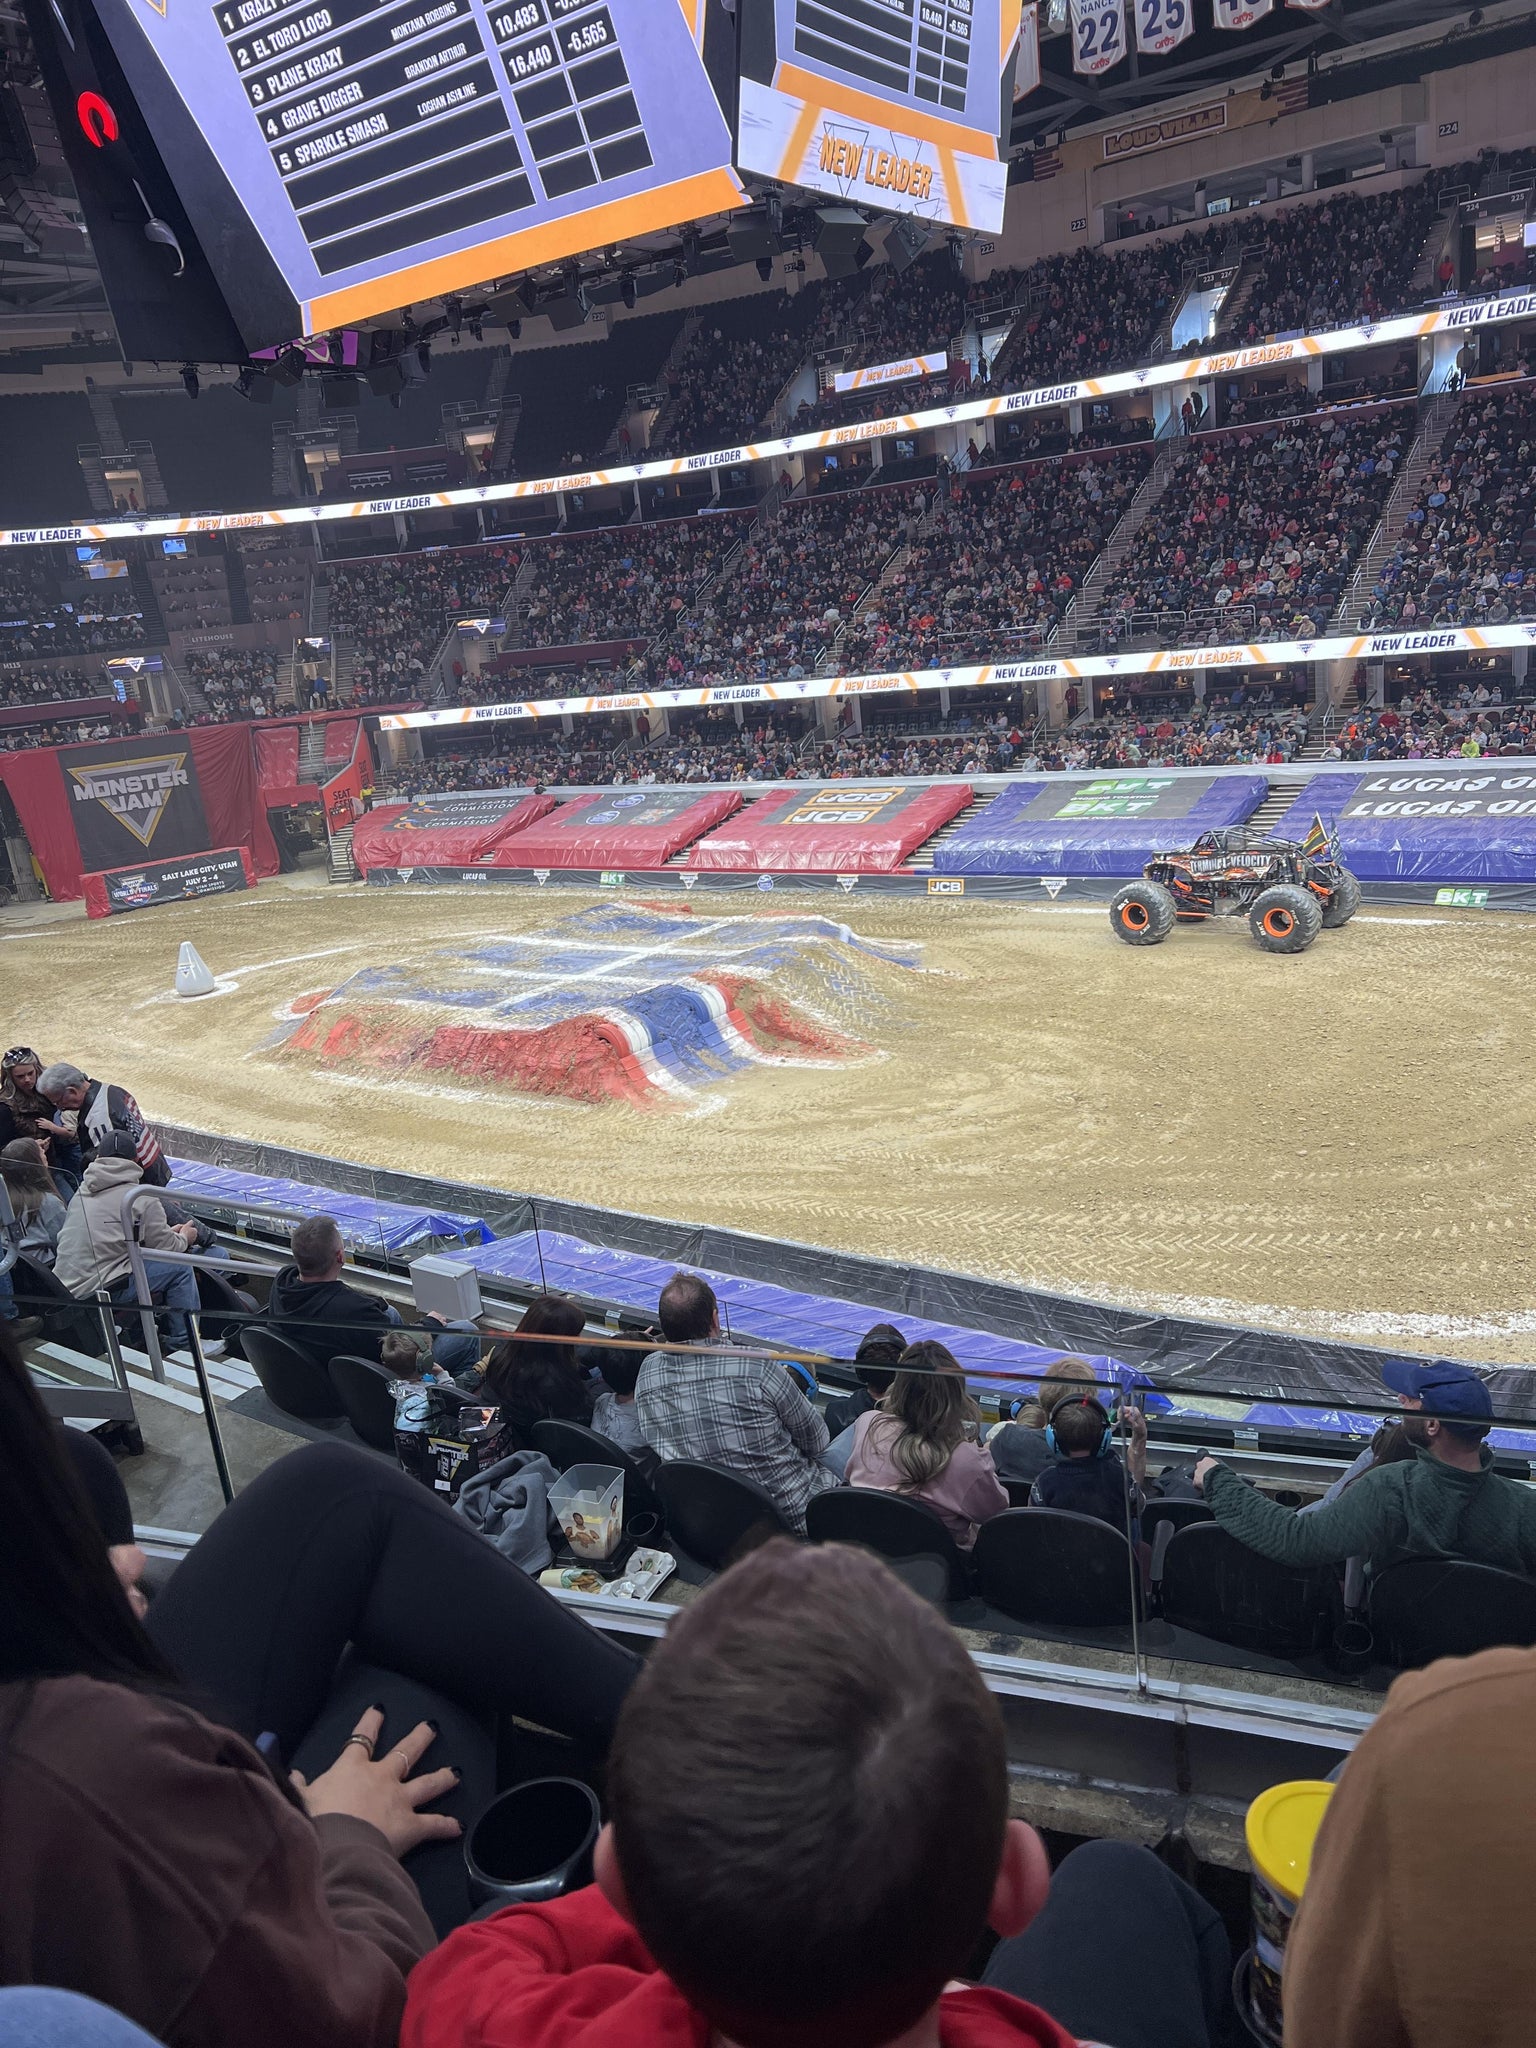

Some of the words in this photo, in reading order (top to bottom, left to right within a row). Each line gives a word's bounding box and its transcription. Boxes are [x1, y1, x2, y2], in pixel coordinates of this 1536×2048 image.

[223, 12, 235, 30] 1
[390, 16, 426, 42] MONTANA
[424, 1, 457, 28] ROBBINS
[495, 3, 539, 37] 10.483
[921, 7, 943, 27] 16.440
[1141, 0, 1186, 39] 25
[949, 16, 968, 36] -6.565
[1078, 9, 1120, 60] 22
[236, 48, 251, 67] 2
[252, 38, 272, 60] EL
[267, 23, 302, 52] TORO
[299, 8, 333, 38] LOCO
[567, 20, 608, 52] -6.565
[404, 53, 440, 80] BRANDON
[437, 42, 468, 63] ARTHUR
[508, 44, 553, 78] 16.440
[251, 83, 265, 101] 3
[265, 64, 308, 96] PLANE
[303, 46, 345, 79] KRAZY
[416, 95, 448, 117] LOGHAN
[446, 82, 478, 107] ASHLINE
[266, 118, 279, 136] 4
[280, 100, 321, 131] GRAVE
[317, 81, 364, 115] DIGGER
[1105, 105, 1225, 156] LOUDVILLE
[1439, 122, 1458, 136] 224
[279, 152, 293, 170] 5
[294, 130, 348, 165] SPARKLE
[345, 112, 389, 144] SMASH
[819, 134, 865, 180] NEW
[864, 147, 933, 199] LEADER
[1466, 202, 1480, 212] 224
[1071, 219, 1086, 231] 223
[981, 243, 994, 255] 222
[1447, 305, 1485, 327] NEW
[1487, 296, 1536, 319] LEADE
[1207, 355, 1240, 372] NEW
[1241, 343, 1294, 366] LEADER
[866, 371, 883, 382] NEW
[885, 364, 914, 379] LEADER
[1006, 393, 1033, 410] NEW
[1034, 385, 1078, 405] LEADER
[835, 428, 859, 444] NEW
[860, 420, 898, 438] LEADER
[688, 457, 706, 470] NEW
[708, 449, 741, 465] LEADER
[532, 479, 555, 494] NEW
[556, 475, 592, 490] LEADER
[369, 500, 392, 513] NEW
[394, 496, 431, 510] LEADER
[196, 516, 221, 530] NEW
[223, 514, 264, 528] LEADER
[11, 532, 37, 543] NEW
[40, 528, 82, 541] LEADER
[192, 633, 234, 643] LITEHOUSE
[1371, 638, 1403, 652] NEW
[1404, 634, 1456, 650] LEADER
[3, 662, 21, 670] M115
[1169, 655, 1196, 667] NEW
[1198, 650, 1243, 665] LEADER
[995, 668, 1018, 680] NEW
[1019, 664, 1057, 677] LEADER
[844, 681, 865, 691] NEW
[865, 677, 901, 689] LEADER
[713, 690, 730, 700] NEW
[731, 687, 761, 699] LEADER
[597, 700, 614, 709] NEW
[614, 697, 640, 708] LEADER
[475, 709, 494, 718] NEW
[495, 706, 523, 717] LEADER
[73, 769, 190, 801] MONSTER
[1364, 776, 1497, 792] LUCAS
[111, 790, 163, 813] JAM
[332, 788, 351, 800] SEAT
[816, 792, 893, 803] JCB
[443, 803, 515, 812] COMMISSION
[1059, 802, 1153, 813] BKT
[1348, 800, 1483, 816] LUCAS
[425, 818, 498, 828] COMMISSION
[791, 811, 870, 822] JCB
[1230, 855, 1272, 868] VELOCITY
[162, 872, 179, 881] SALT
[180, 869, 200, 878] LAKE
[199, 865, 218, 875] CITY,
[218, 860, 238, 871] UTAH
[601, 873, 625, 884] BKT
[185, 877, 201, 886] JULY
[930, 880, 961, 892] JCB
[113, 889, 133, 898] WORLD
[138, 884, 158, 894] FINALS
[1438, 892, 1487, 904] BKT
